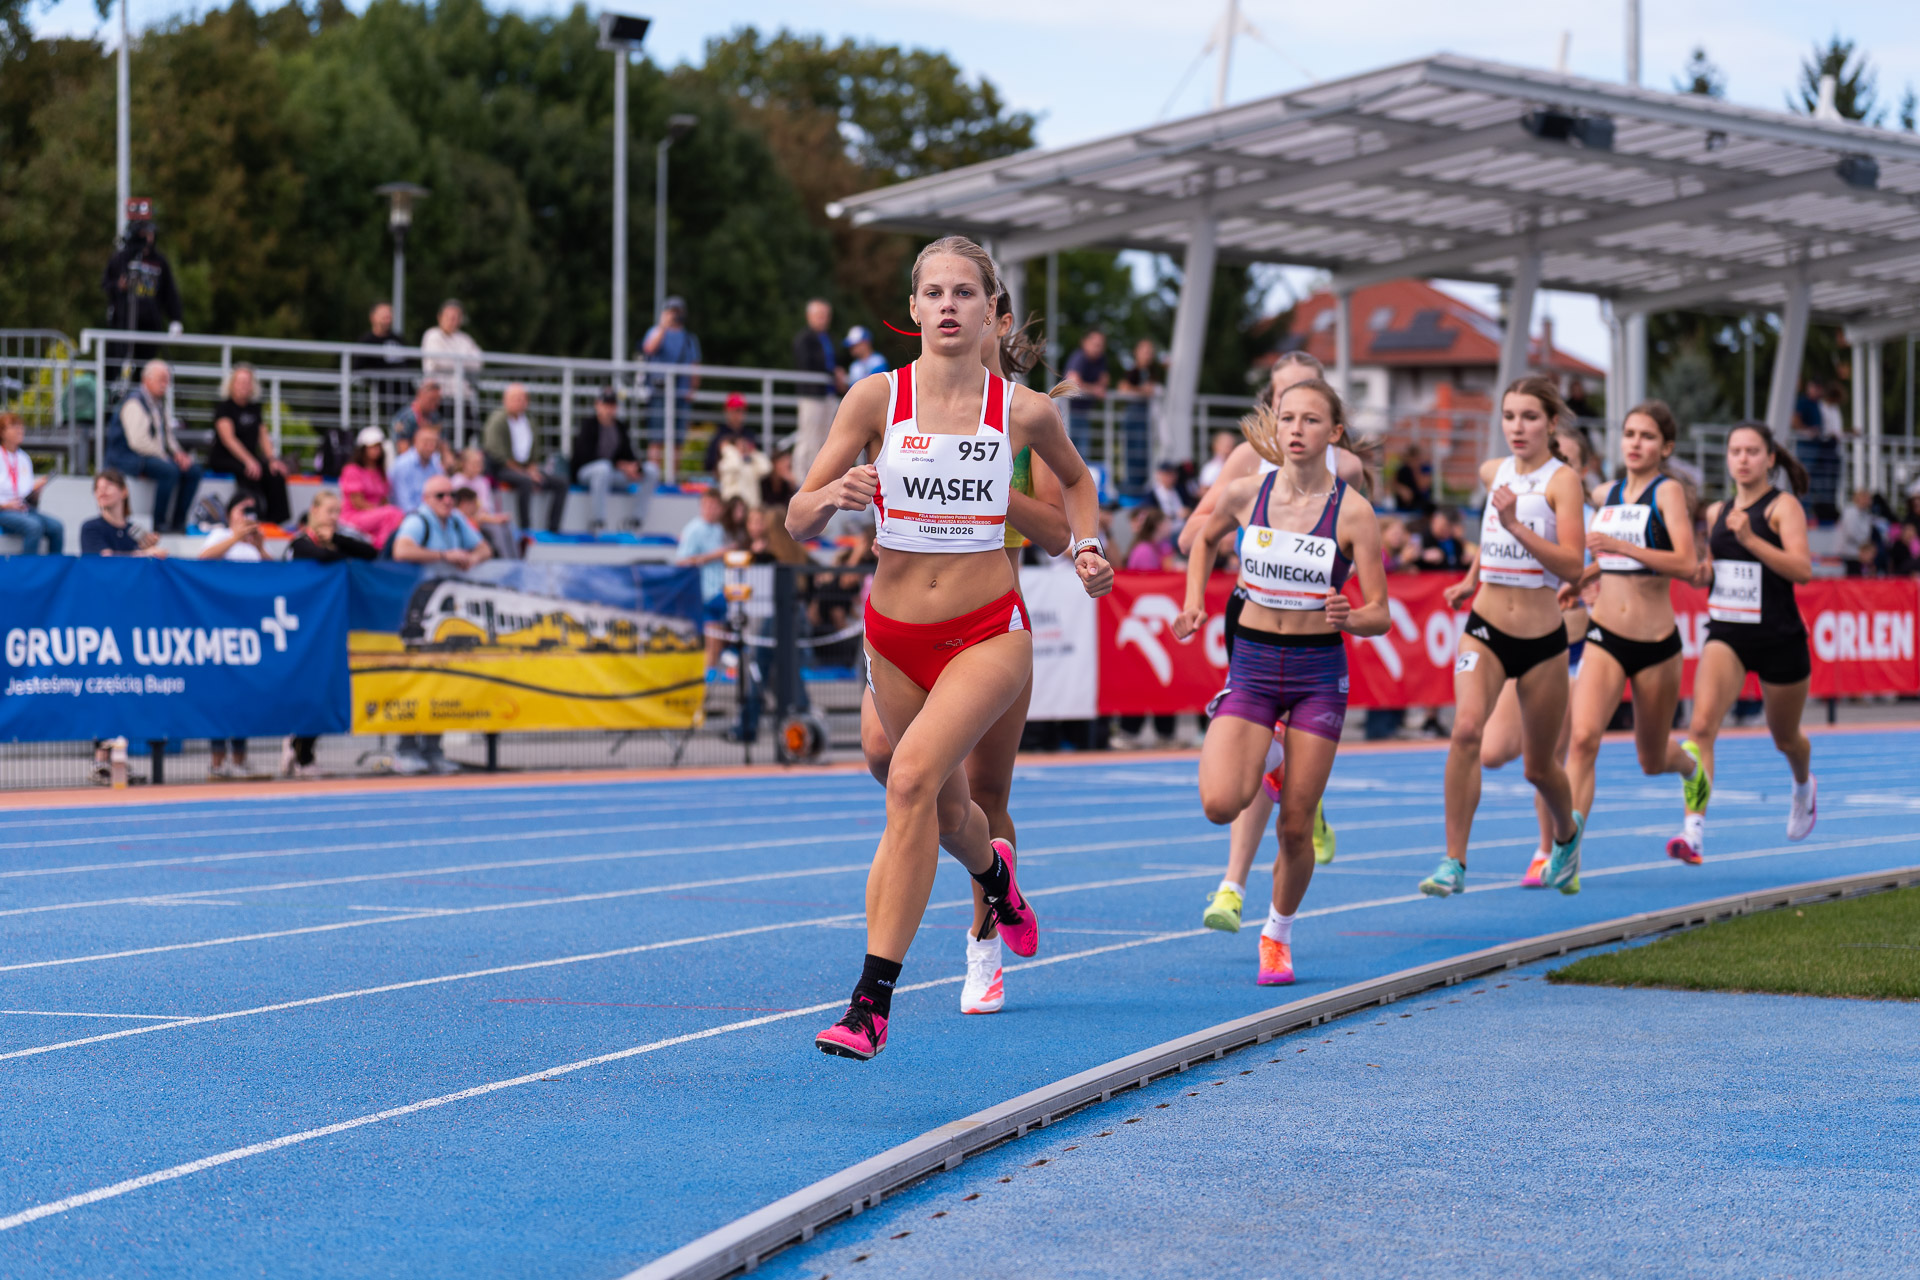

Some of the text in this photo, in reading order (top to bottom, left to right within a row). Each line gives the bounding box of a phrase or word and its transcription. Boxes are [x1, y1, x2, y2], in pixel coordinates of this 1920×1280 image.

[901, 435, 1000, 462] RCU 957
[902, 476, 994, 505] WĄSEK
[918, 525, 974, 535] LUBIN 2026
[1294, 538, 1326, 557] 746
[1244, 558, 1327, 585] GLINIECKA
[1261, 596, 1303, 607] LUBIN 2026
[5, 626, 262, 667] GRUPA LUXMED
[1813, 610, 1915, 662] ORLEN
[5, 674, 84, 697] Jesteśmy
[85, 674, 144, 696] częścią
